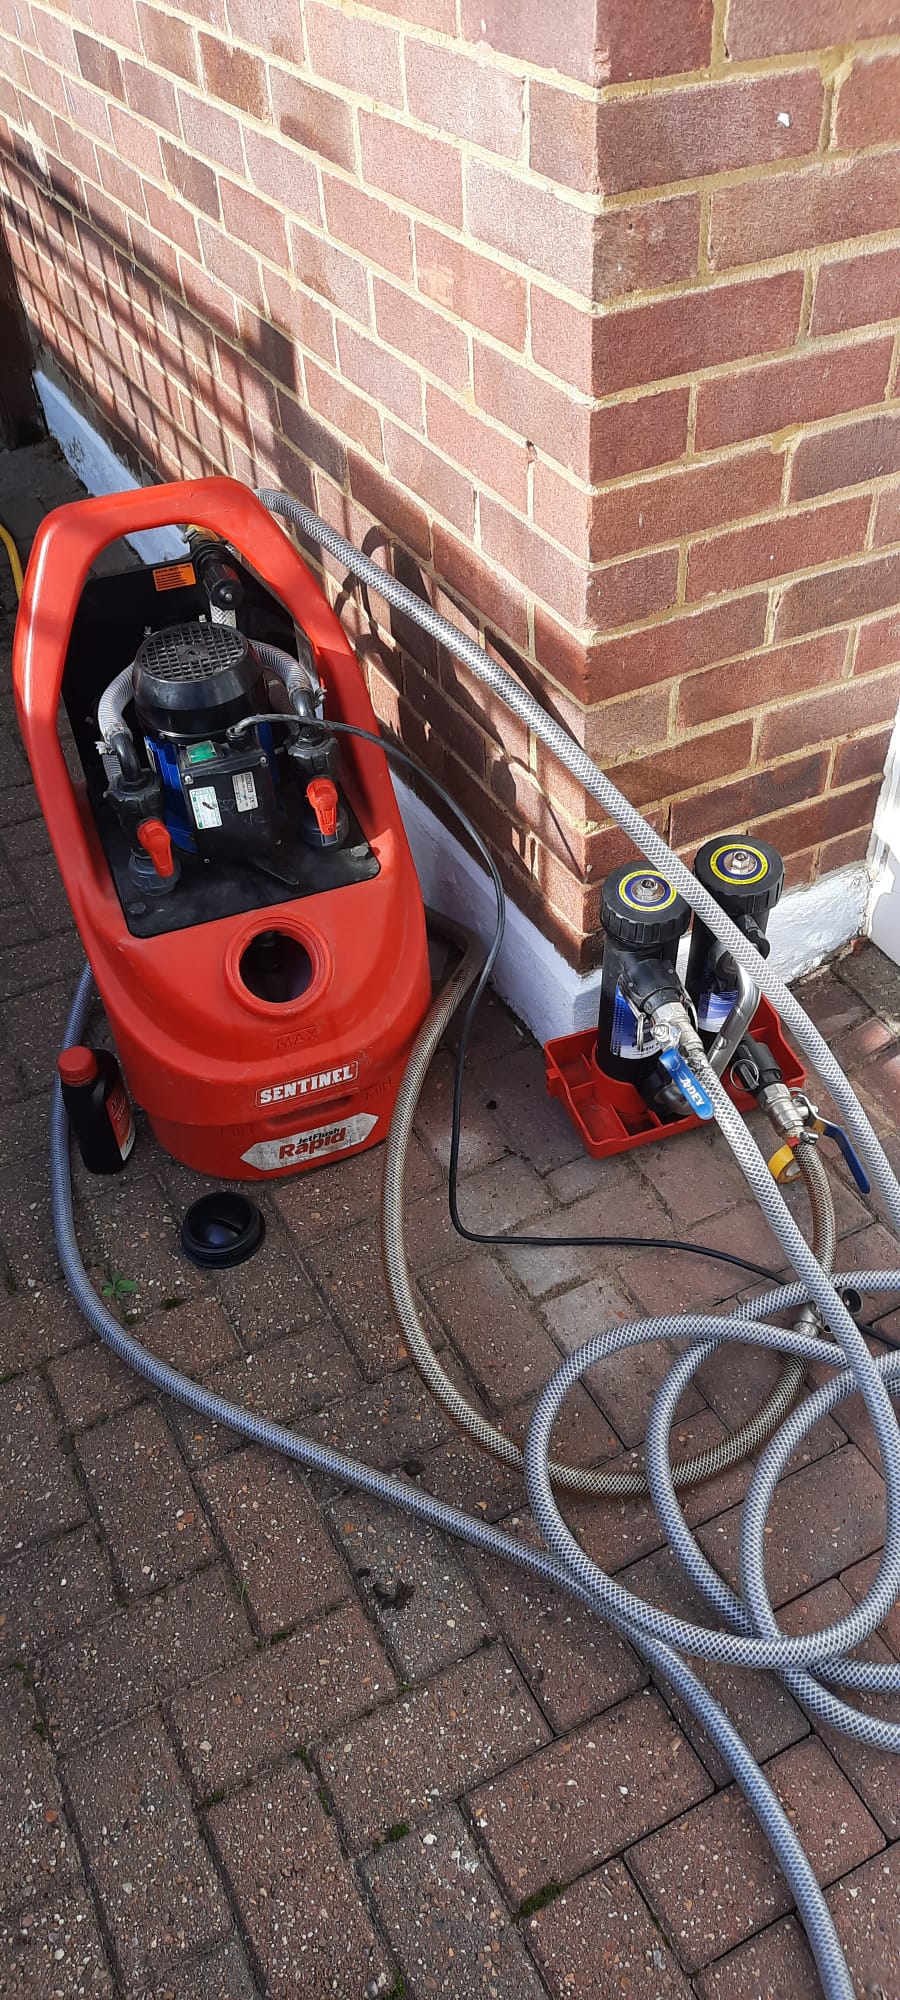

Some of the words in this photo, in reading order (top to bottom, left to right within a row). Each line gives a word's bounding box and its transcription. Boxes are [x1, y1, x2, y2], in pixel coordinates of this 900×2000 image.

[260, 1065, 353, 1104] SENTINEL
[279, 1127, 347, 1159] Rapid
[296, 1128, 340, 1145] JetFlush
